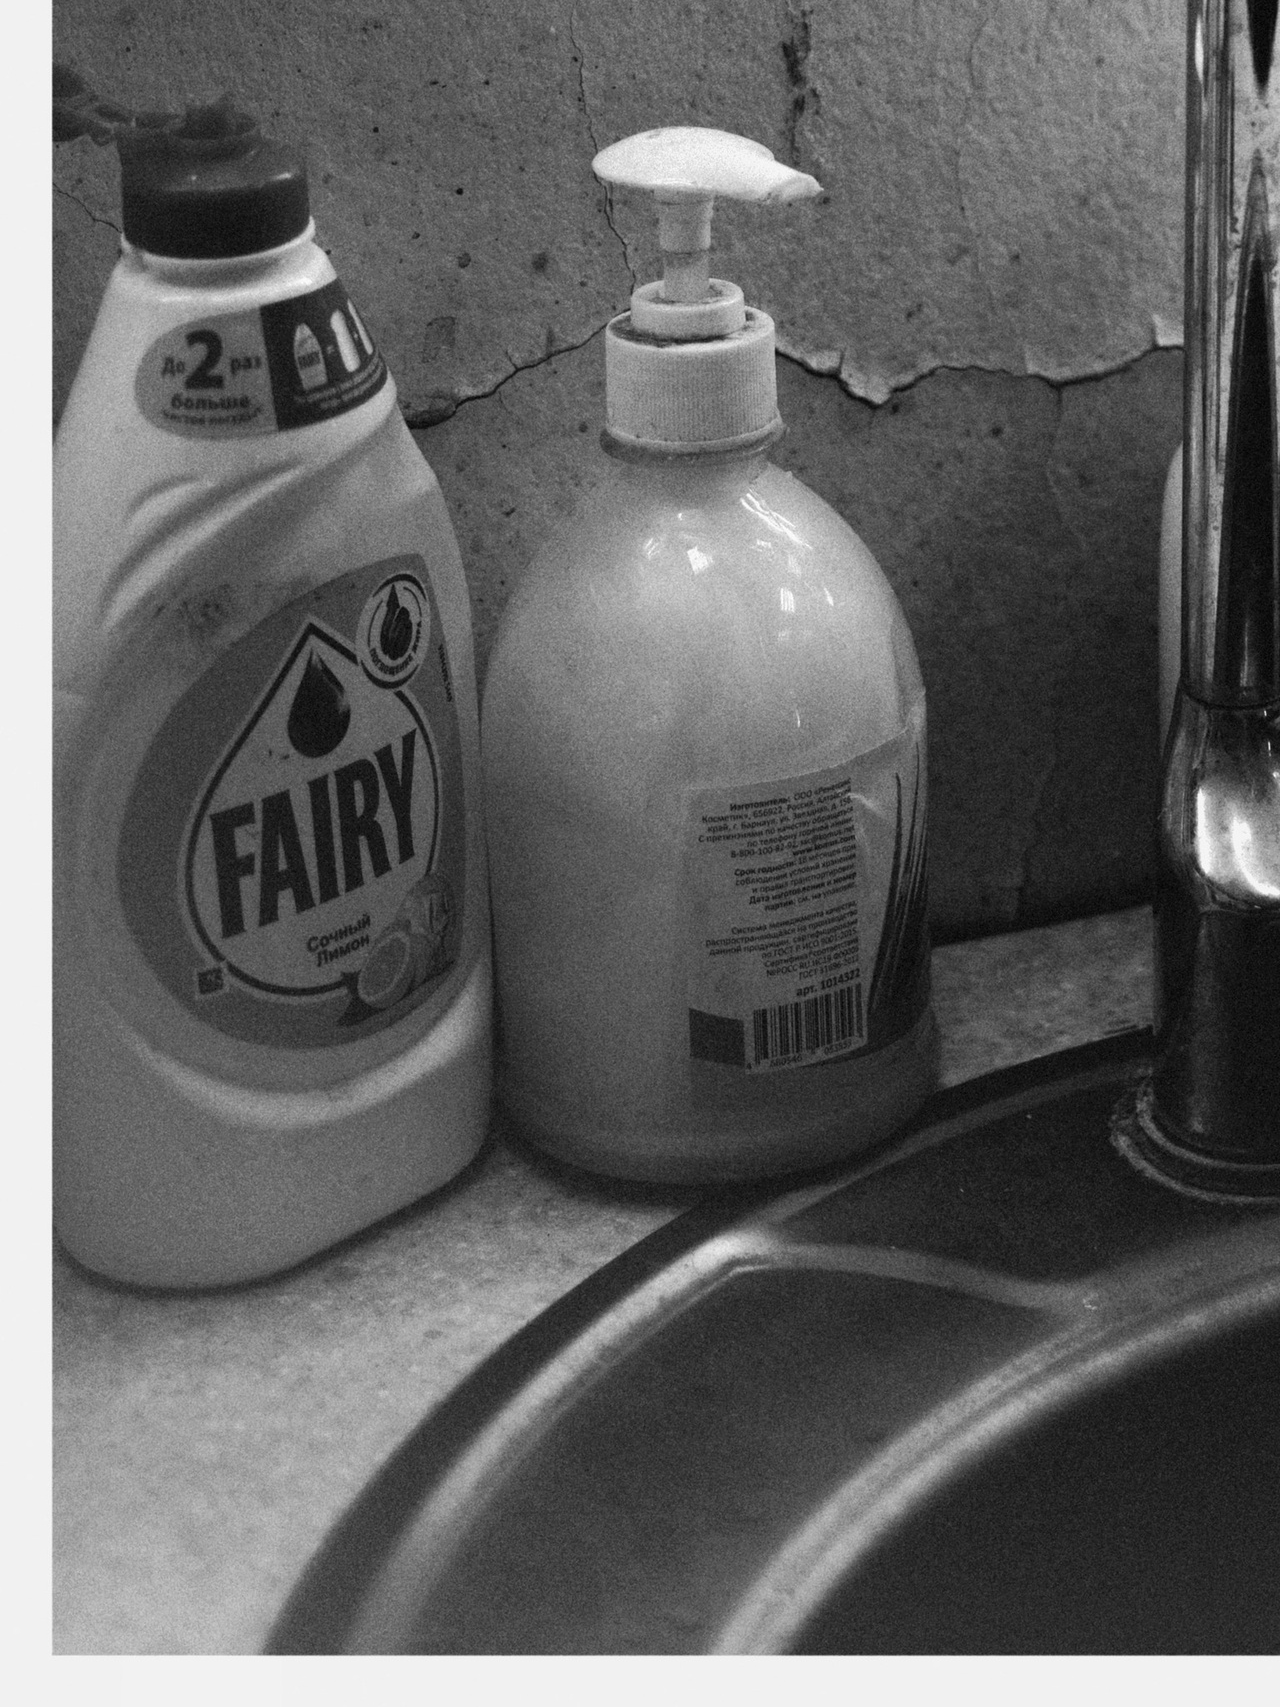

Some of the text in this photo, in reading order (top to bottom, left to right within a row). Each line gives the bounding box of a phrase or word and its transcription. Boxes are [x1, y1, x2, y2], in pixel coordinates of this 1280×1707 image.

[184, 329, 224, 389] 2
[230, 356, 262, 376] раз
[170, 392, 251, 410] больше
[208, 727, 419, 940] FAIRY
[734, 867, 756, 877] Срок
[306, 910, 372, 953] Сочный
[731, 923, 767, 934] Система
[315, 934, 371, 968] Лимон
[796, 981, 818, 998] арт.
